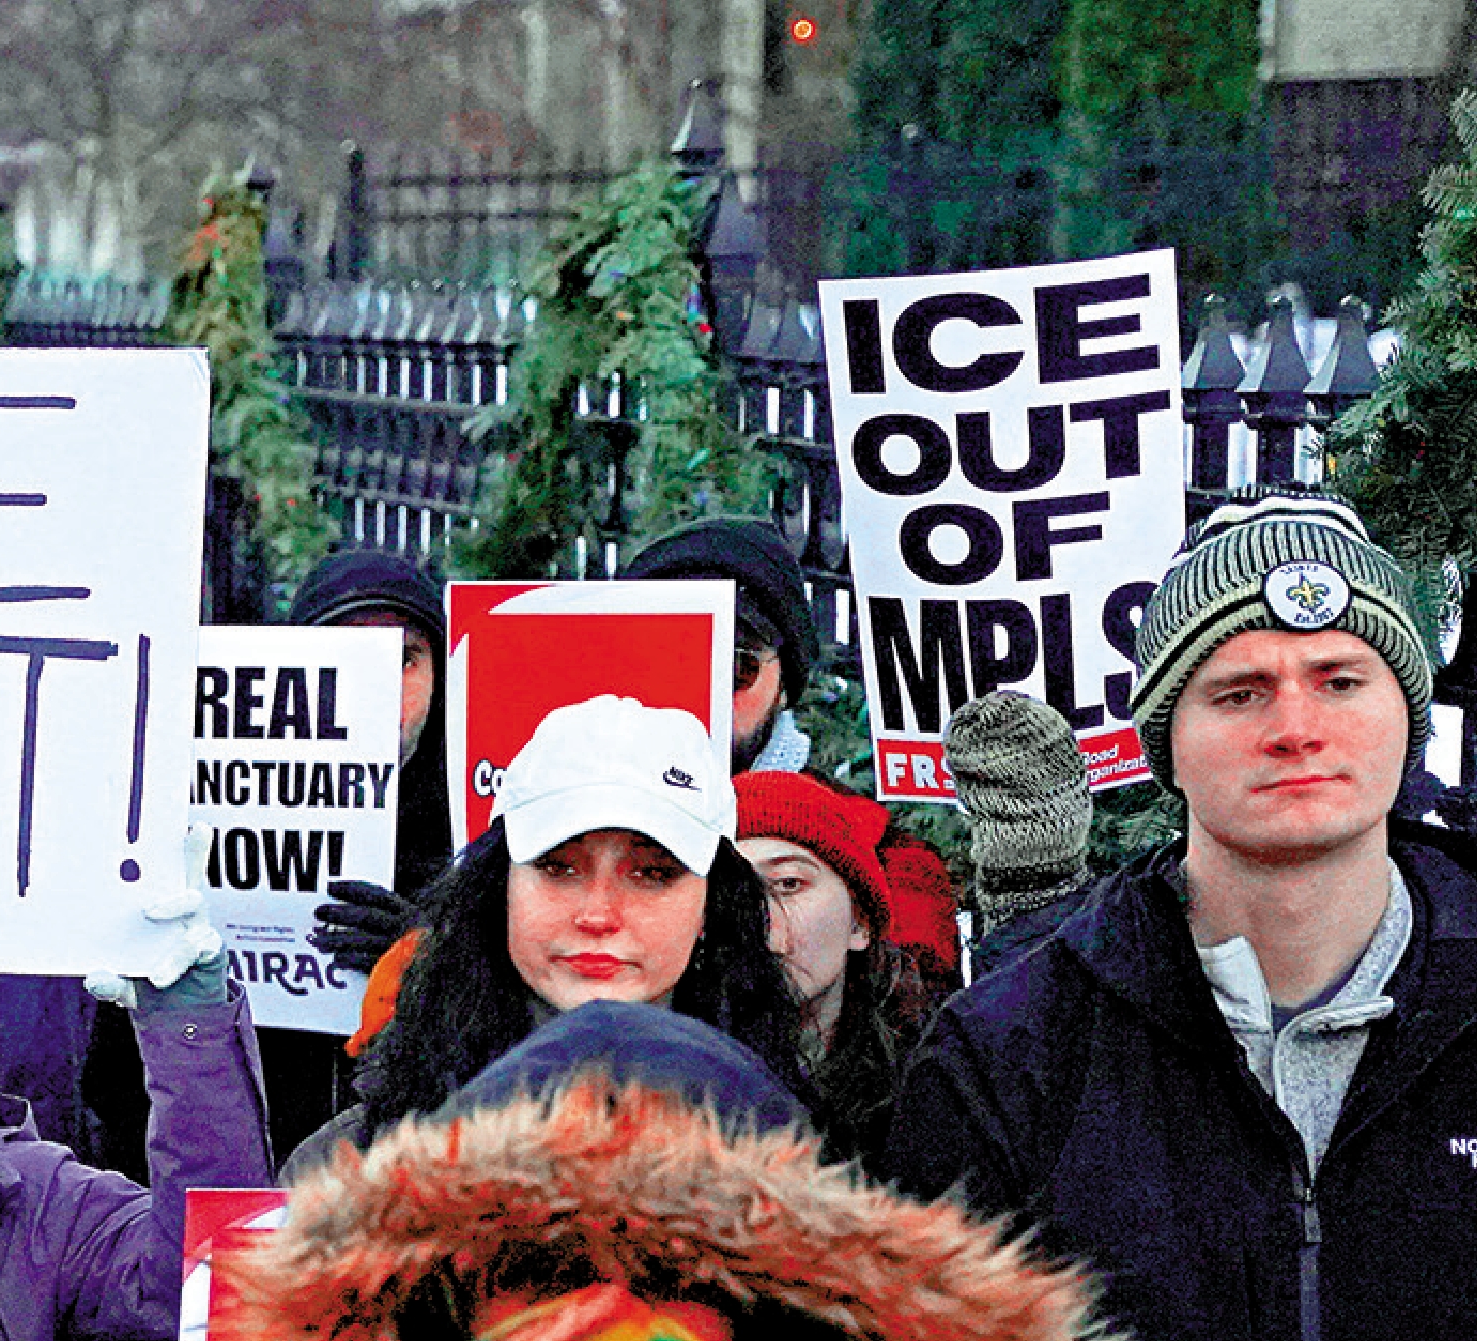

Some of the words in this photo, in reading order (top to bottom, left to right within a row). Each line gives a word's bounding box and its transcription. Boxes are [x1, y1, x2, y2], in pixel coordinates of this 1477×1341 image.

[843, 273, 1160, 394] ICE
[851, 390, 1171, 496] OUT
[898, 491, 1112, 587] OF
[193, 665, 348, 741] REAL
[190, 759, 395, 809] NCTUARY
